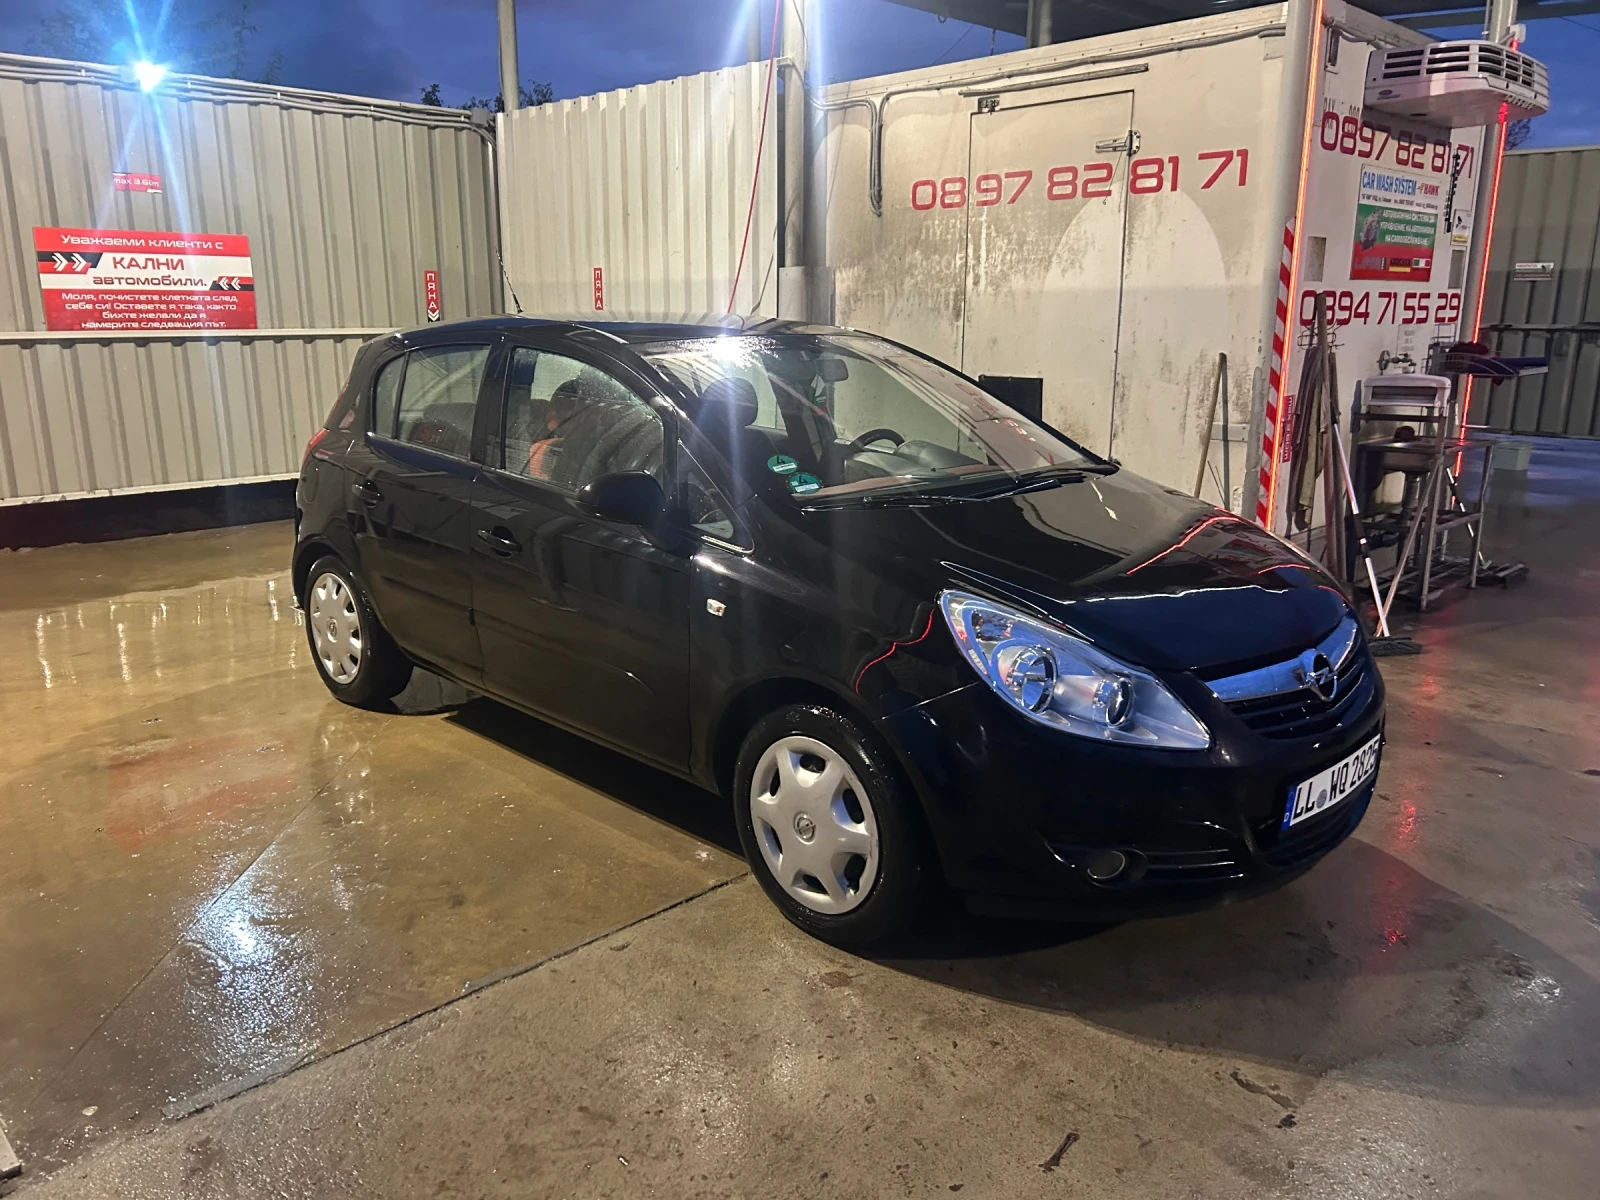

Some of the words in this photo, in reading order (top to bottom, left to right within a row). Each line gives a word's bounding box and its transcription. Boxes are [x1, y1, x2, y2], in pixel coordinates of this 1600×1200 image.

[1320, 111, 1391, 160] 0897
[1395, 130, 1427, 170] 82
[1431, 139, 1452, 175] 81
[1457, 144, 1475, 179] 71
[911, 170, 1033, 211] 0897
[1047, 162, 1113, 201] 82
[1130, 156, 1180, 195] 81
[1198, 149, 1249, 190] 71
[1362, 171, 1376, 190] CAR
[1376, 173, 1394, 193] WASH
[1394, 176, 1417, 196] SYSTEM
[60, 234, 145, 247] Уважаеми
[148, 239, 212, 249] клиенти
[215, 241, 223, 249] с
[113, 256, 184, 271] КАЛНИ
[93, 274, 207, 287] автомобили.
[62, 292, 96, 301] Моля,
[427, 273, 437, 309] ПЯНА
[65, 301, 93, 309] себе
[178, 303, 205, 311] така,
[1377, 292, 1398, 325] 71
[1401, 292, 1431, 324] 55
[1435, 292, 1461, 323] 29
[102, 310, 137, 319] бихте
[183, 312, 197, 320] да
[81, 321, 139, 329] намерите
[141, 321, 203, 329] следващия
[1293, 781, 1315, 820] LL
